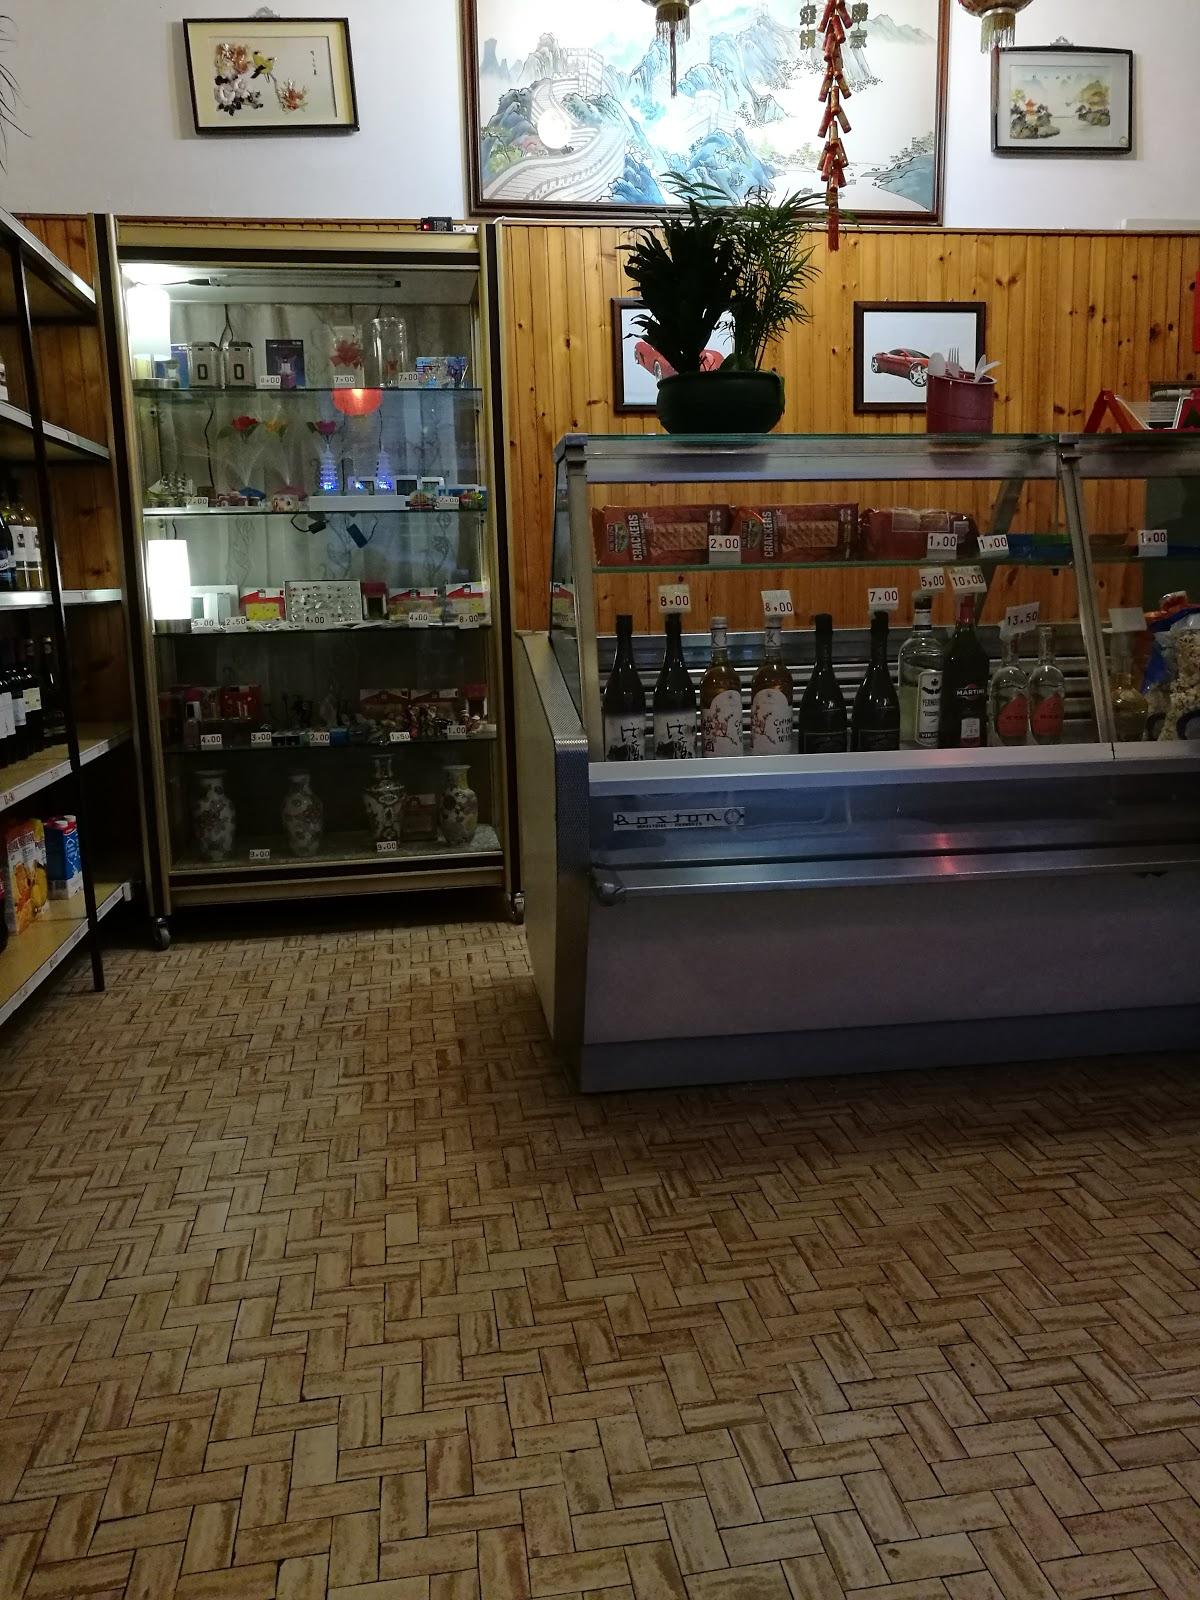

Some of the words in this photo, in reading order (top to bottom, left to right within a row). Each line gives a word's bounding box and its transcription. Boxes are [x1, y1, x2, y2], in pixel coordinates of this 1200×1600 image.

[627, 514, 643, 561] CRACKERS
[762, 511, 774, 557] CRACKERS
[956, 688, 985, 697] MARTINI
